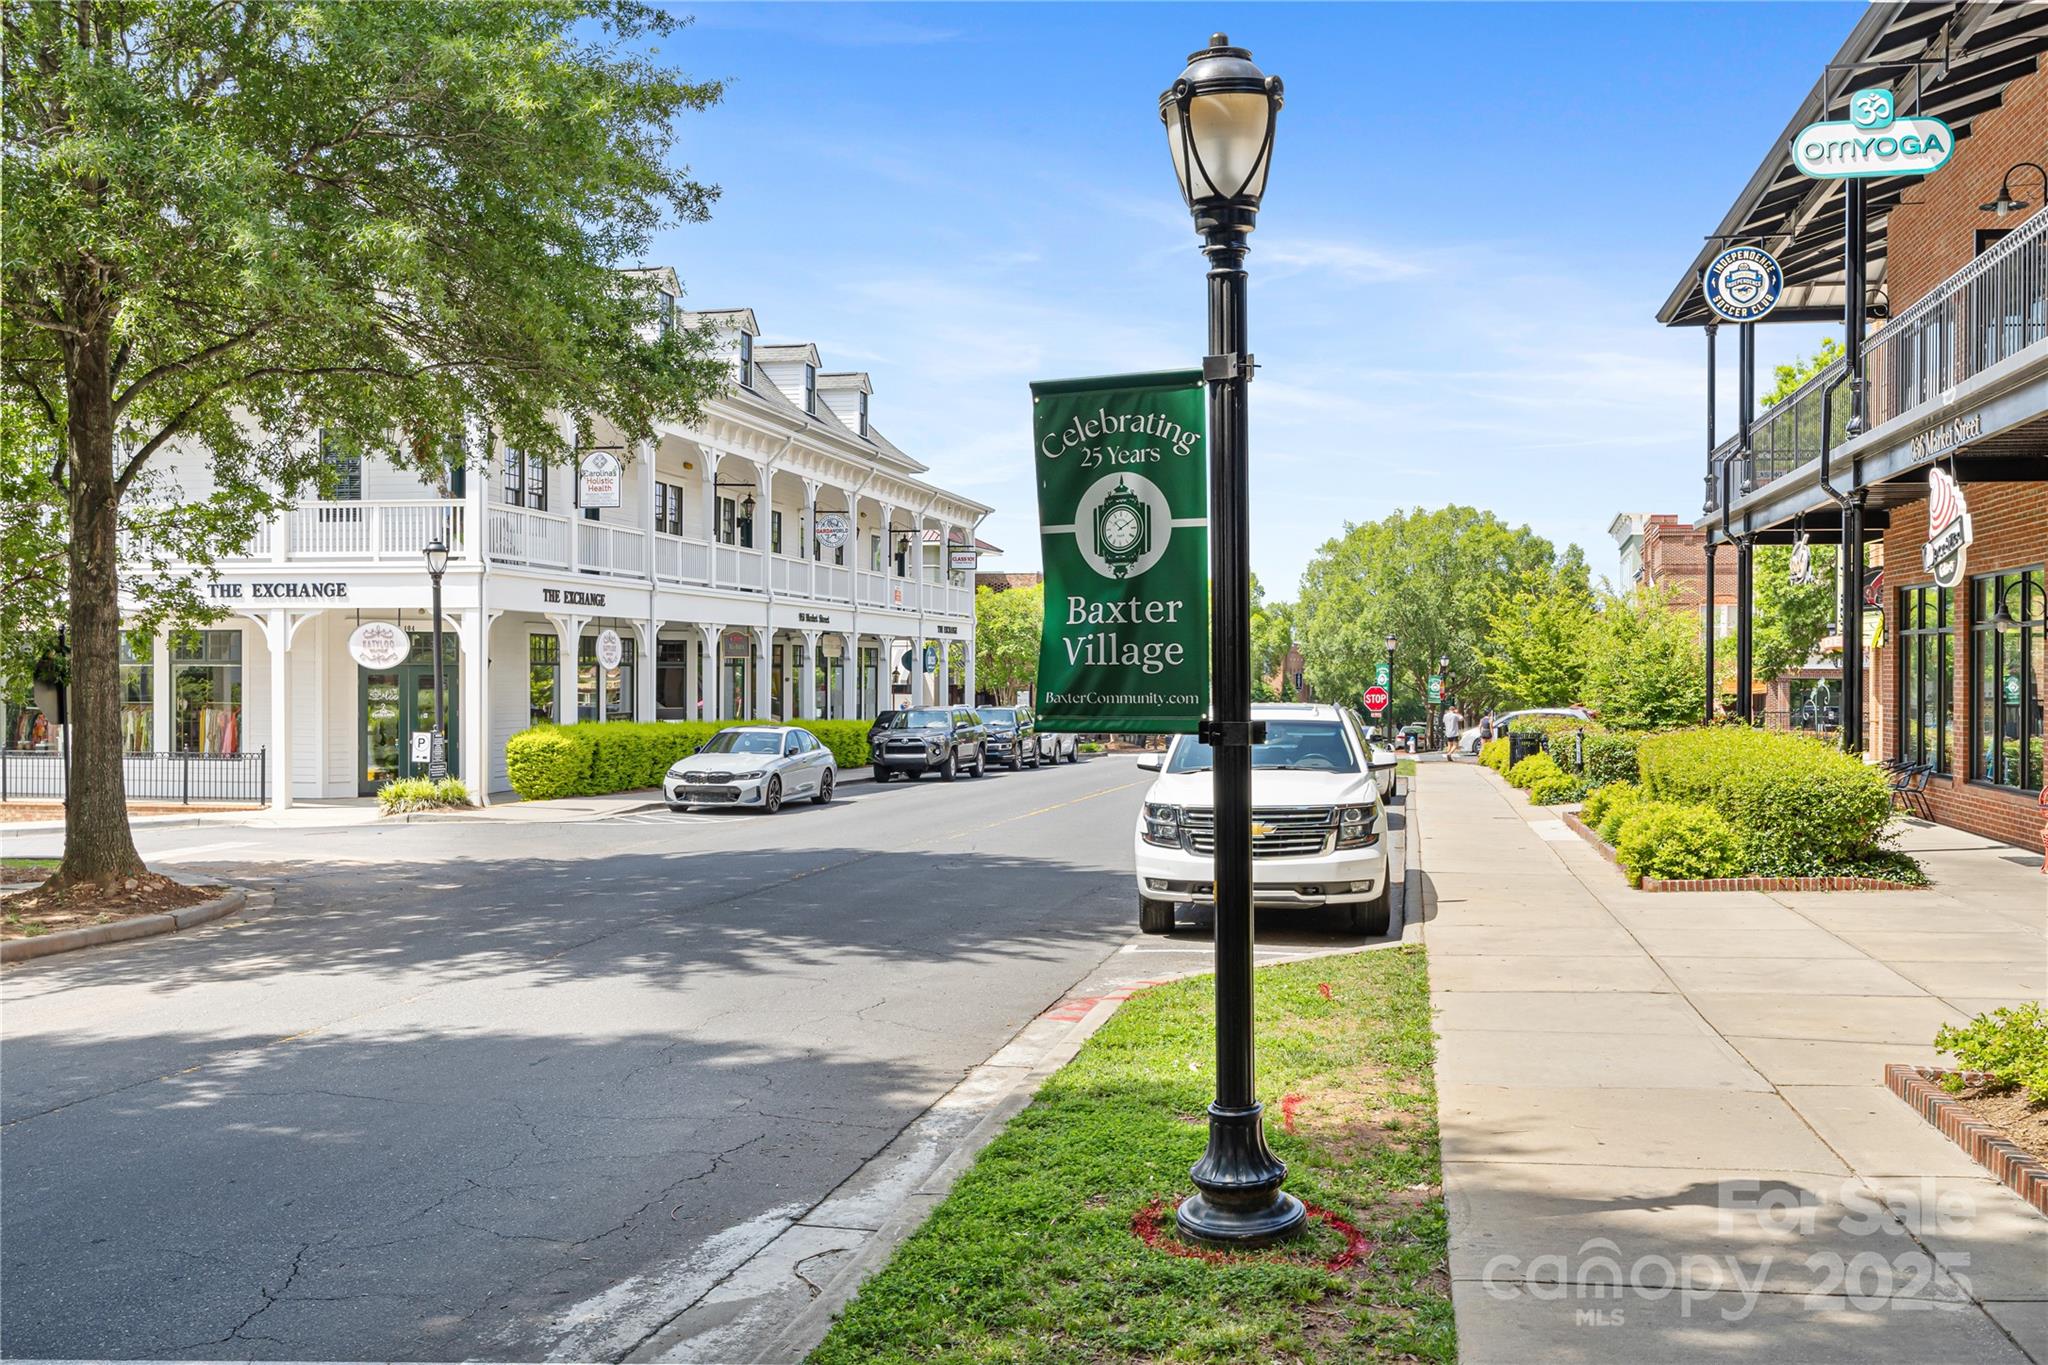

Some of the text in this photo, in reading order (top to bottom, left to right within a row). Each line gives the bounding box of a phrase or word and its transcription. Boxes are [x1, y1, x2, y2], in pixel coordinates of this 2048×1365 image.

[1712, 250, 1776, 274] INDEPENDENCE
[1712, 293, 1775, 317] SOCCER CLUB
[1041, 407, 1201, 457] Celebrating
[1925, 424, 1954, 458] Market
[1954, 416, 1981, 445] Street
[1080, 445, 1161, 469] 25 Years
[586, 477, 614, 485] Holistic
[207, 583, 347, 598] THE EXCHANGE
[542, 588, 607, 607] THE EXCHANGE
[1066, 596, 1183, 625] Baxter
[1062, 632, 1184, 674] Village
[1045, 691, 1199, 707] BaxterCommunity.com
[1365, 694, 1386, 704] STOP
[417, 737, 426, 748] P
